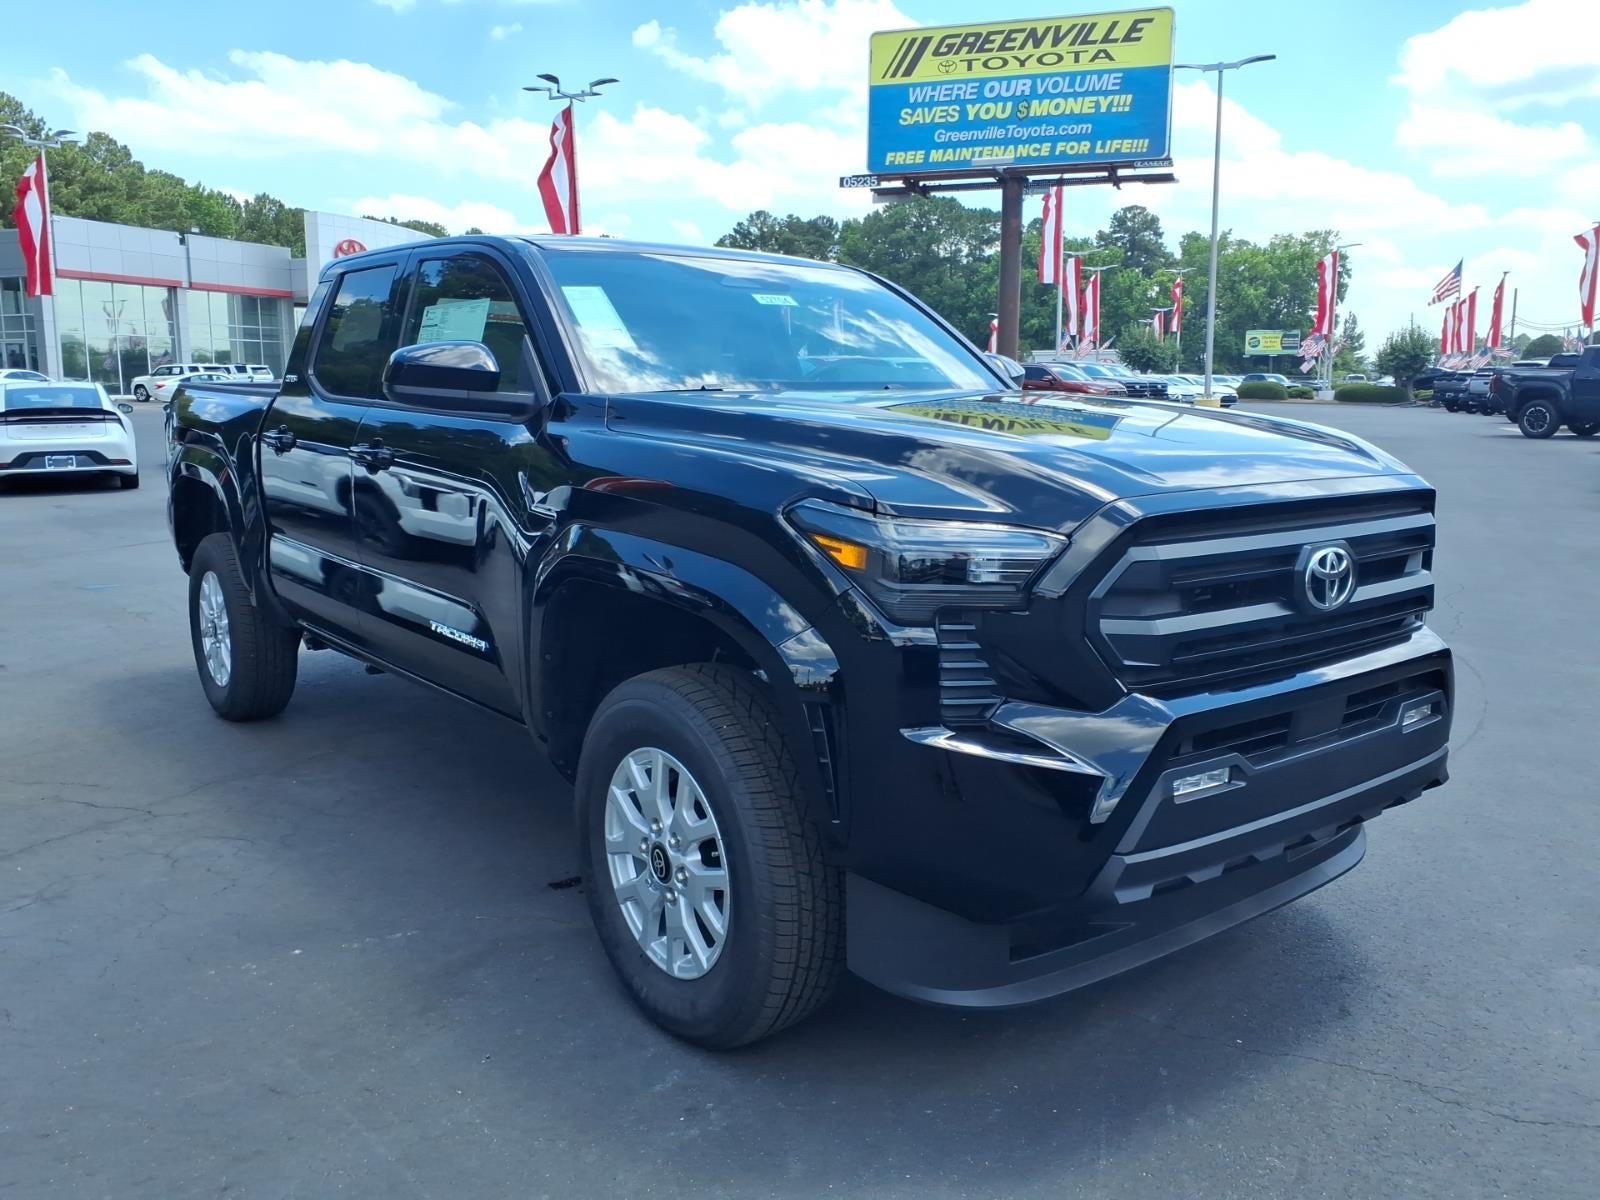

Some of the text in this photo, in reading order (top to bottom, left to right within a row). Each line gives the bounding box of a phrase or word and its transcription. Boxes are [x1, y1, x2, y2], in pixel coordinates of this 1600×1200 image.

[931, 18, 1155, 57] GREENVILLE
[959, 48, 1116, 72] TOYOTA
[908, 73, 1123, 104] WHERE OUR VOLUME
[899, 105, 960, 126] SAVES
[966, 99, 1012, 121] YOU
[934, 123, 1092, 143] GreenvilleToyota.com
[884, 138, 1149, 166] FREE MAINTENANCE FOR LIFE!!!
[842, 176, 878, 187] 05235
